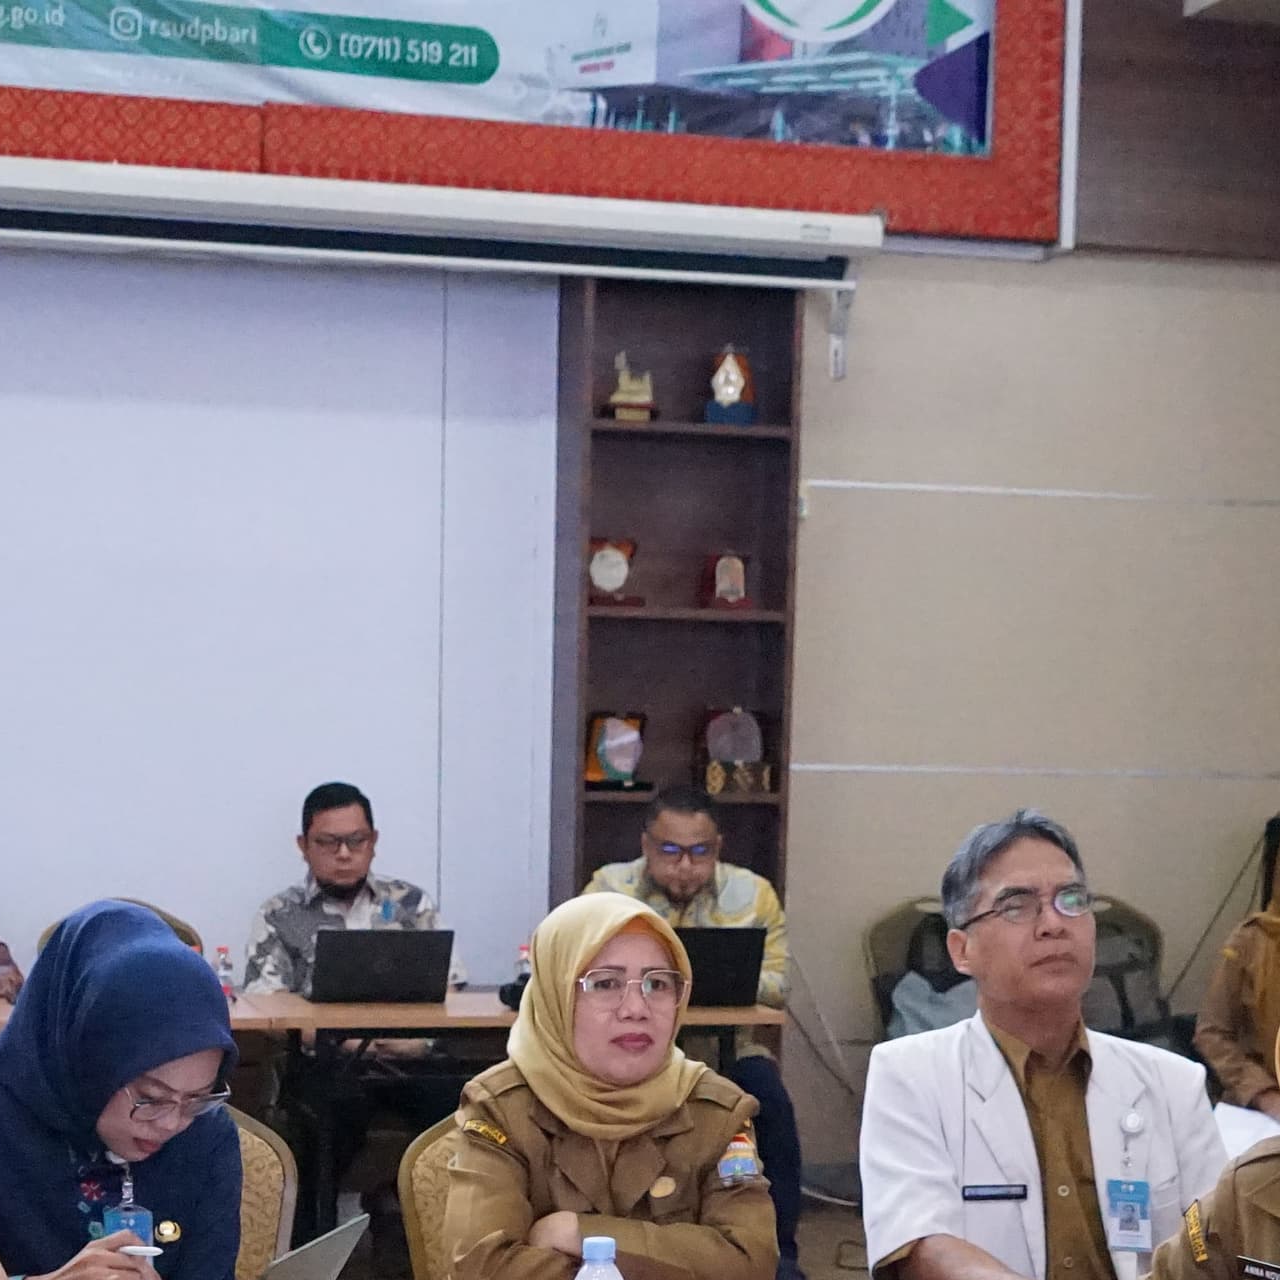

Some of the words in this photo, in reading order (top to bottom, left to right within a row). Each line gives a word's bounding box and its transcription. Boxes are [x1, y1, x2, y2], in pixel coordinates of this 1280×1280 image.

[149, 17, 257, 45] rsudpbari
[338, 32, 402, 62] (0711)
[406, 41, 443, 65] 519
[448, 44, 479, 68] 211
